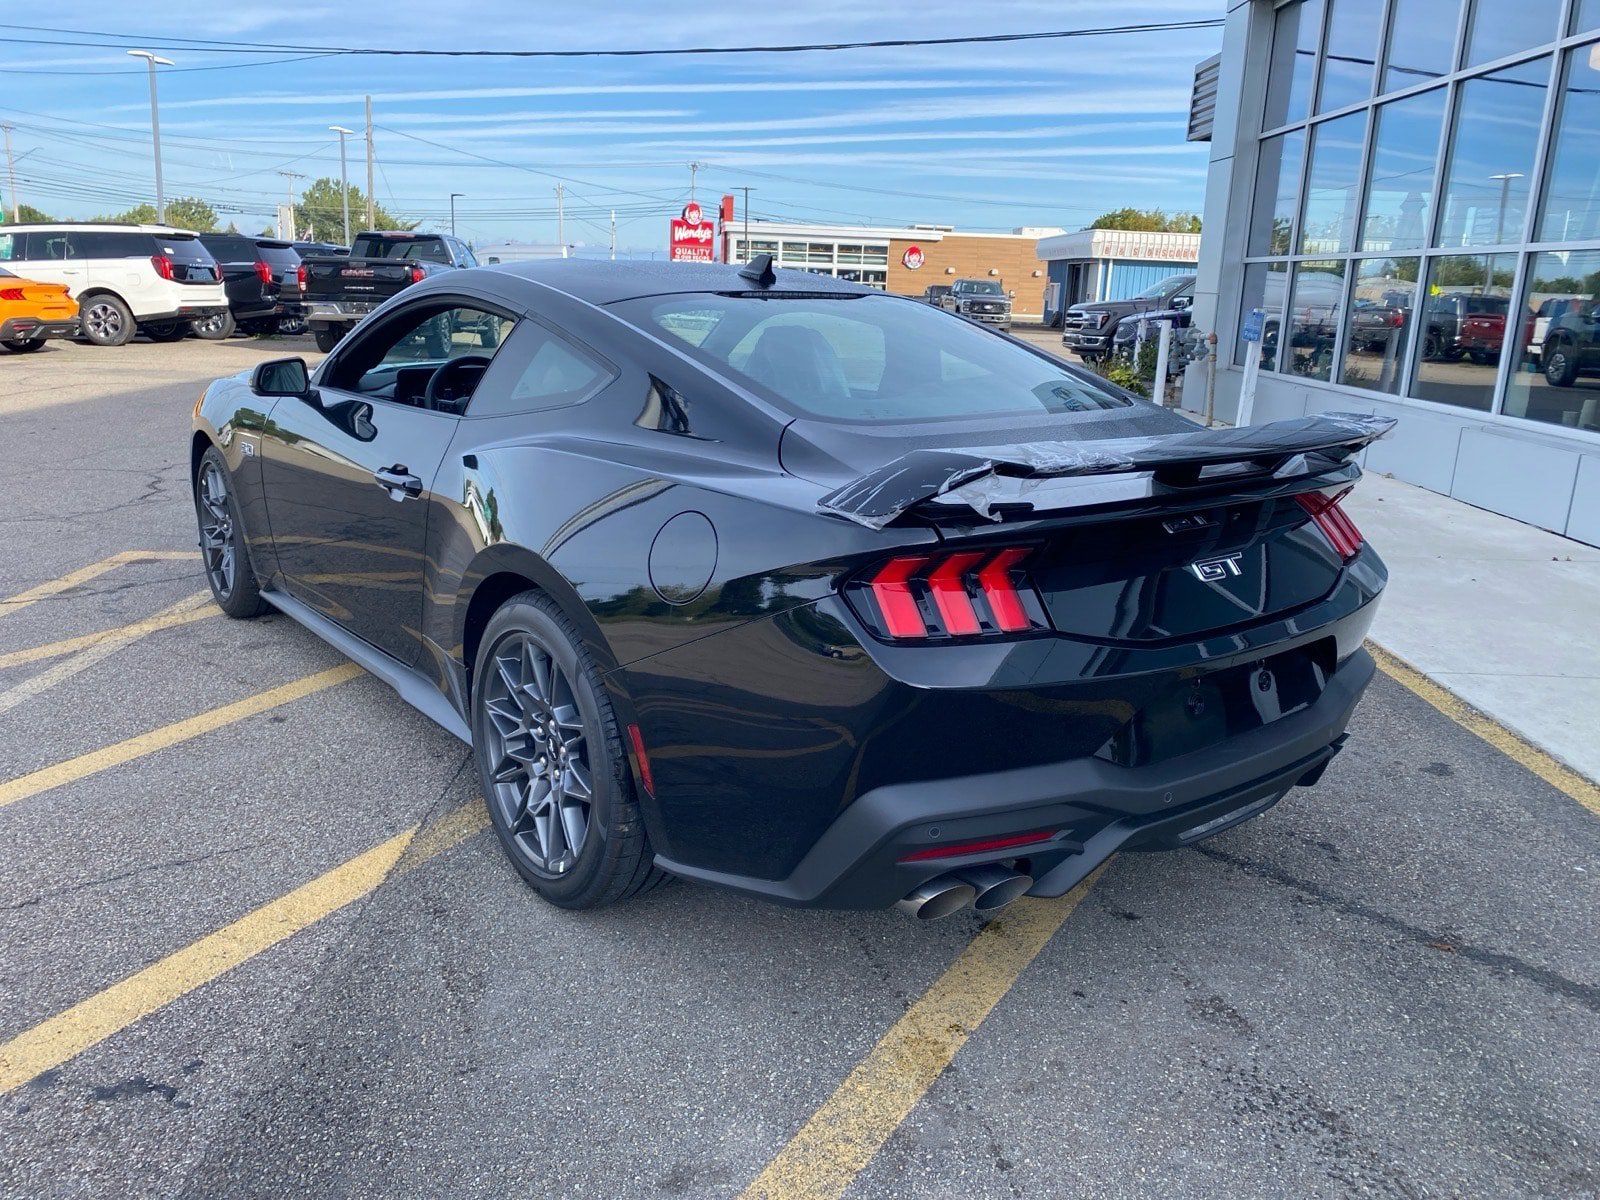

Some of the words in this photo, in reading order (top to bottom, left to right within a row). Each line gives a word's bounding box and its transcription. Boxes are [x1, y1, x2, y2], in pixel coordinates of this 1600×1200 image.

[674, 225, 713, 243] Wendy's
[675, 247, 711, 256] QUALITY
[341, 269, 374, 277] GMC
[1191, 551, 1243, 582] GT
